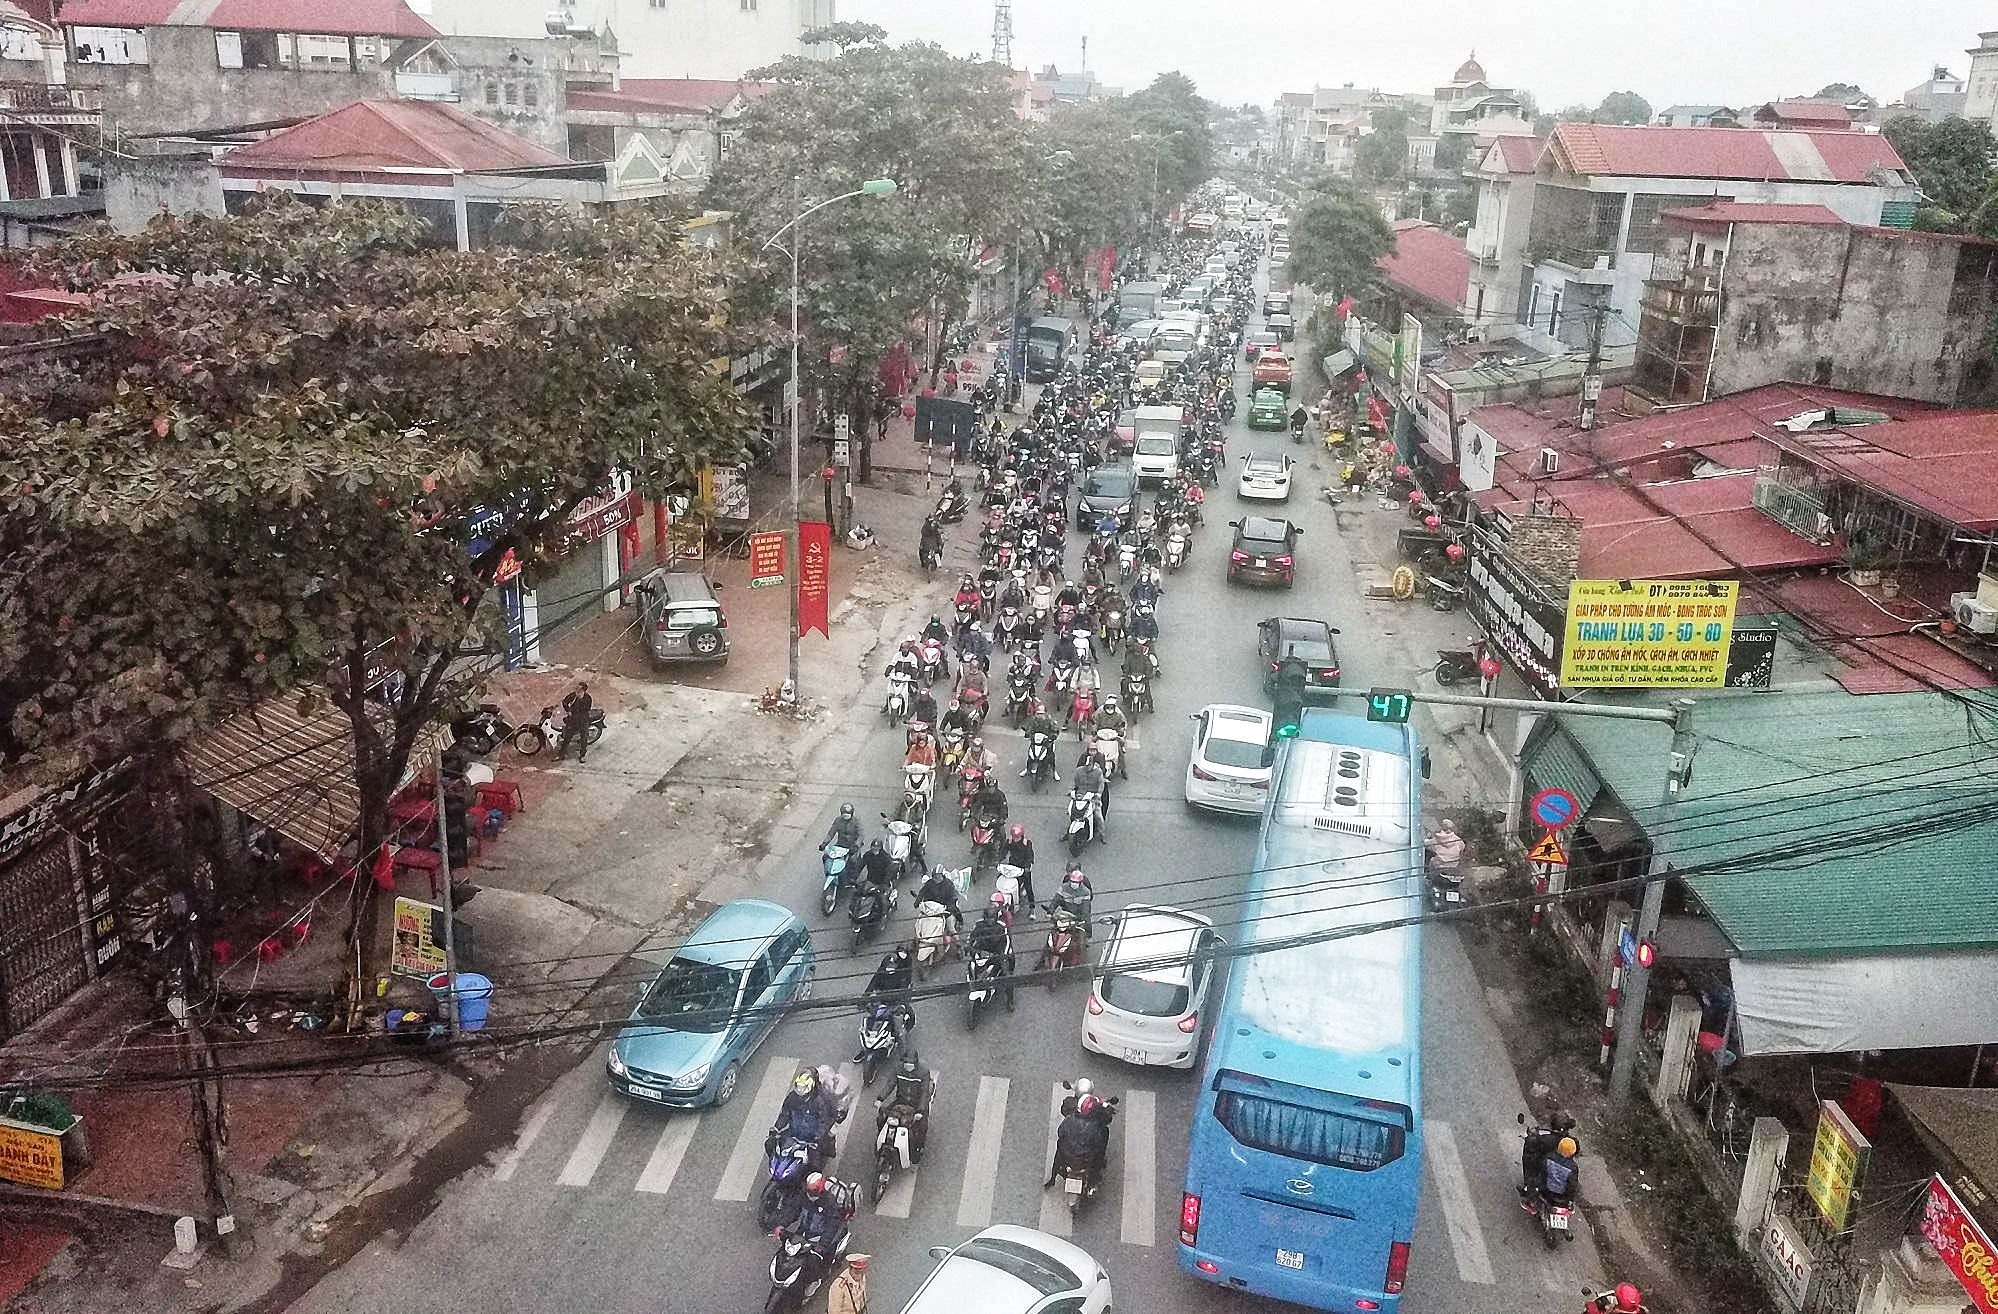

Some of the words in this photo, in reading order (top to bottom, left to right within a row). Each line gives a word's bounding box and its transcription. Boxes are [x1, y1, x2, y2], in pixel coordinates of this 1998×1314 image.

[1590, 602, 1607, 617] PHÁP
[1609, 604, 1621, 617] CHO
[1577, 622, 1617, 641] TRANH
[1621, 622, 1644, 646] LỤA
[1648, 623, 1664, 641] 3D
[1677, 623, 1692, 641] 5D
[1705, 623, 1721, 641] 8D
[1738, 632, 1772, 642] Studio
[1373, 694, 1408, 718] 47
